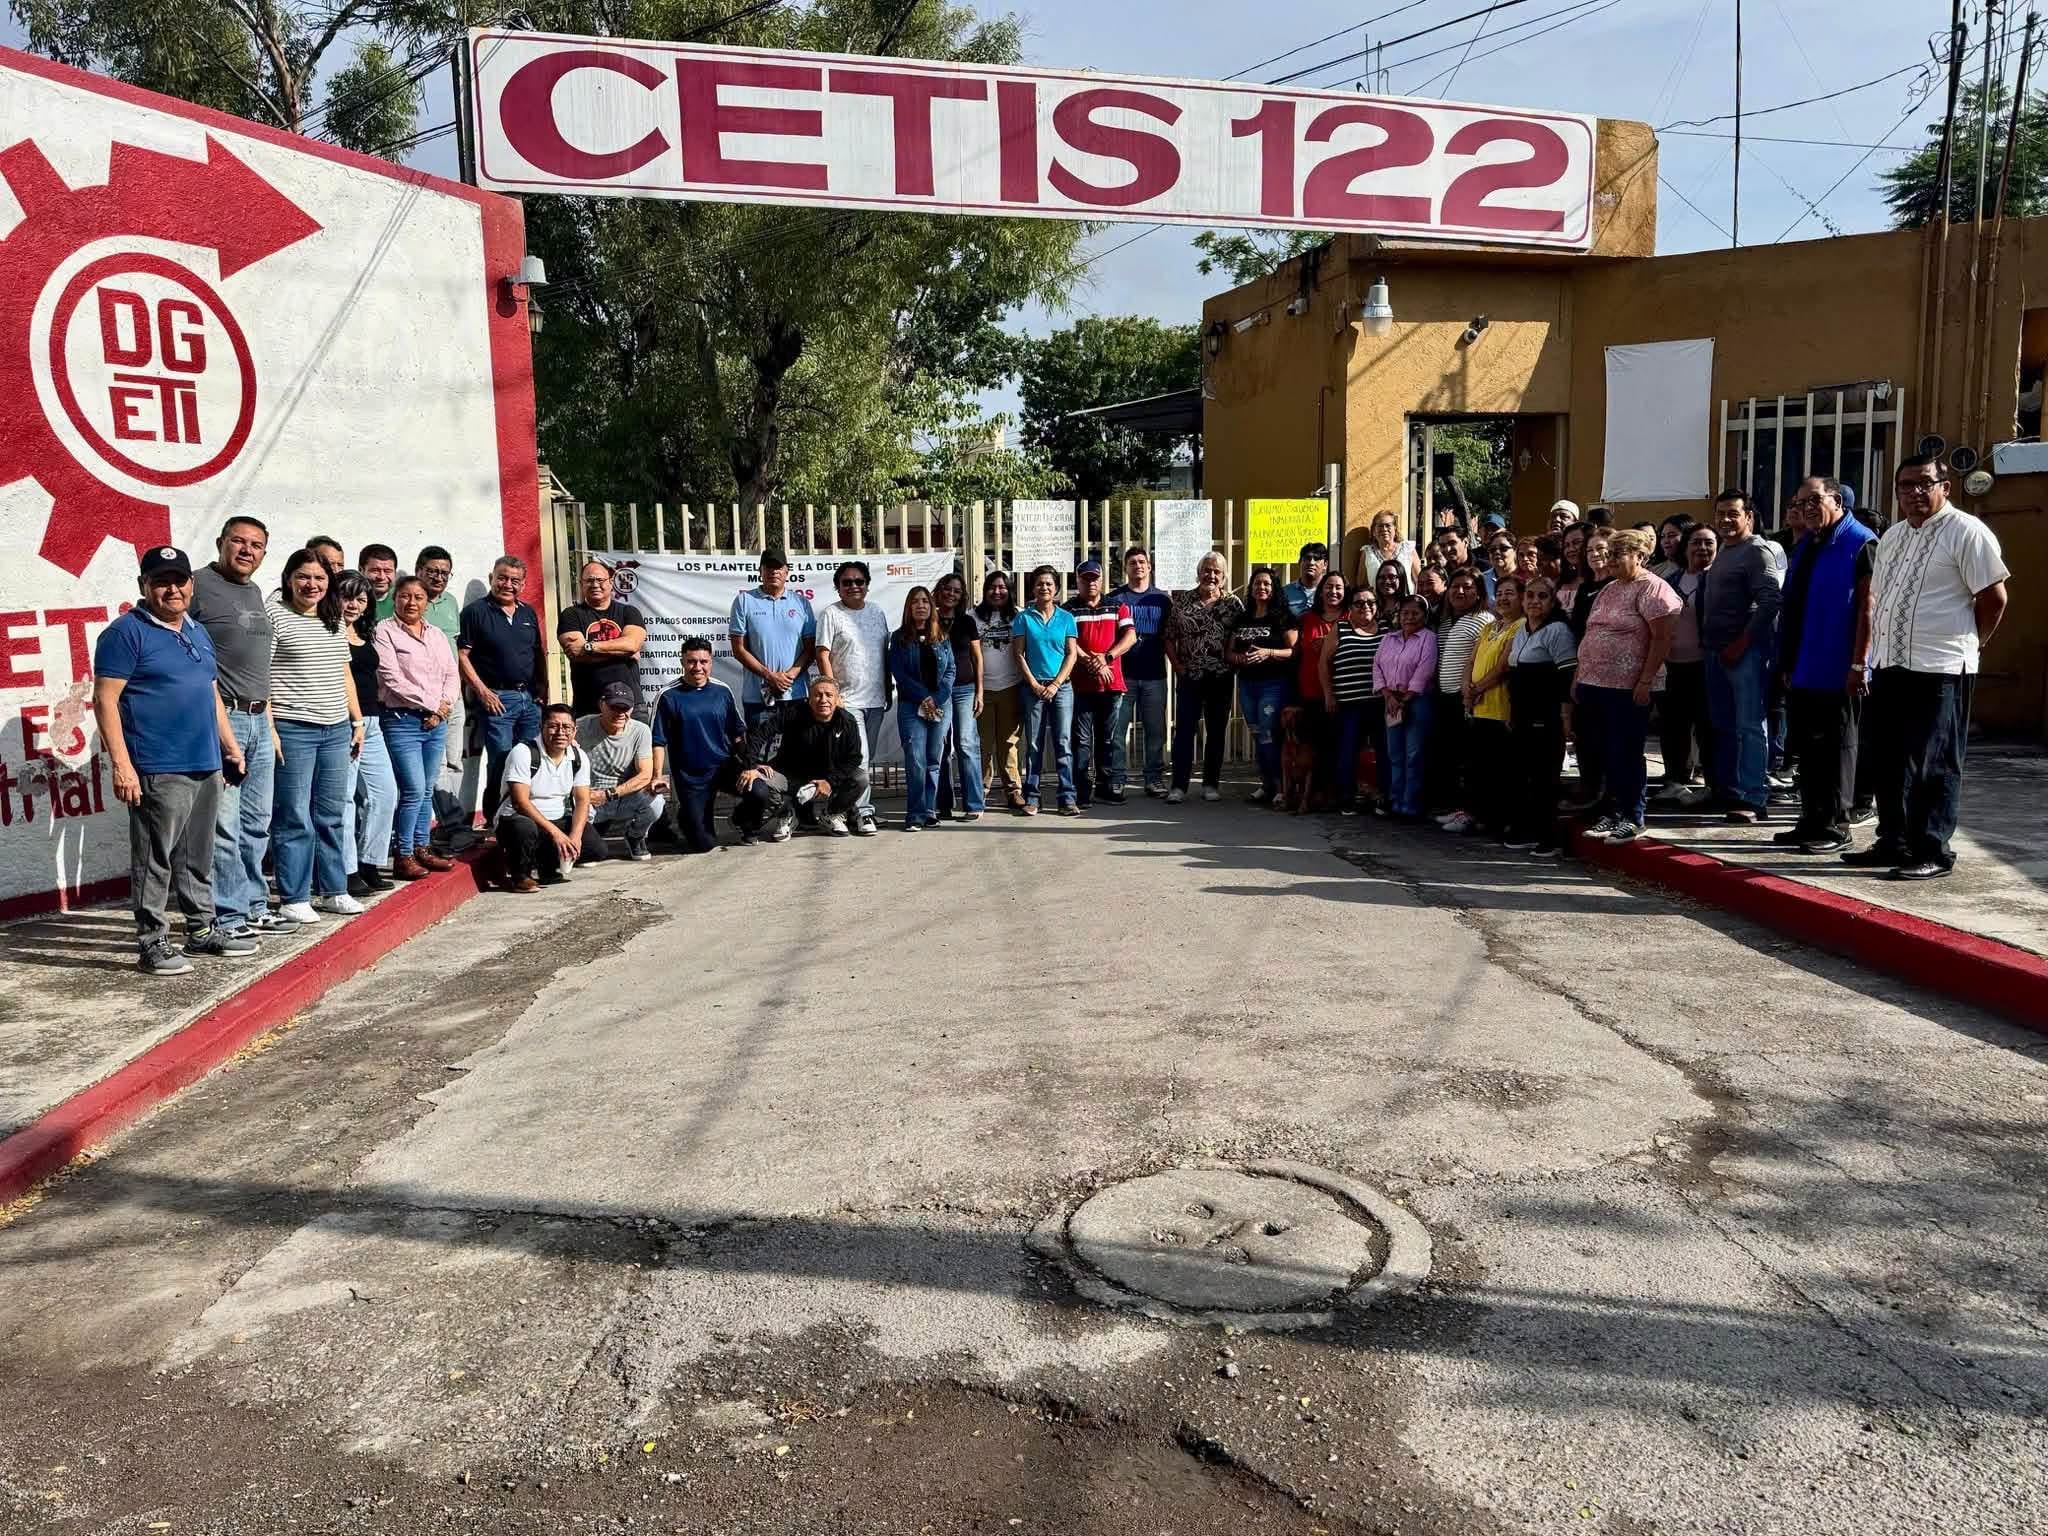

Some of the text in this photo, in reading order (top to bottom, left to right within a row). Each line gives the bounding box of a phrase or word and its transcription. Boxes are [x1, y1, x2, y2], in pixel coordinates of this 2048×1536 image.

[499, 49, 1569, 233] CETIS 122
[97, 286, 207, 374] DG
[108, 372, 202, 444] ETI
[677, 562, 701, 571] LOS
[705, 562, 760, 572] PLANTEL
[798, 562, 813, 571] LA
[816, 562, 841, 571] DGE
[886, 564, 913, 576] SNTE
[643, 617, 731, 625] OS PAGOS CORRESPOND
[644, 633, 677, 642] STÍMULO
[716, 633, 726, 641] DE
[661, 667, 684, 675] PENDI
[641, 684, 664, 692] PREST
